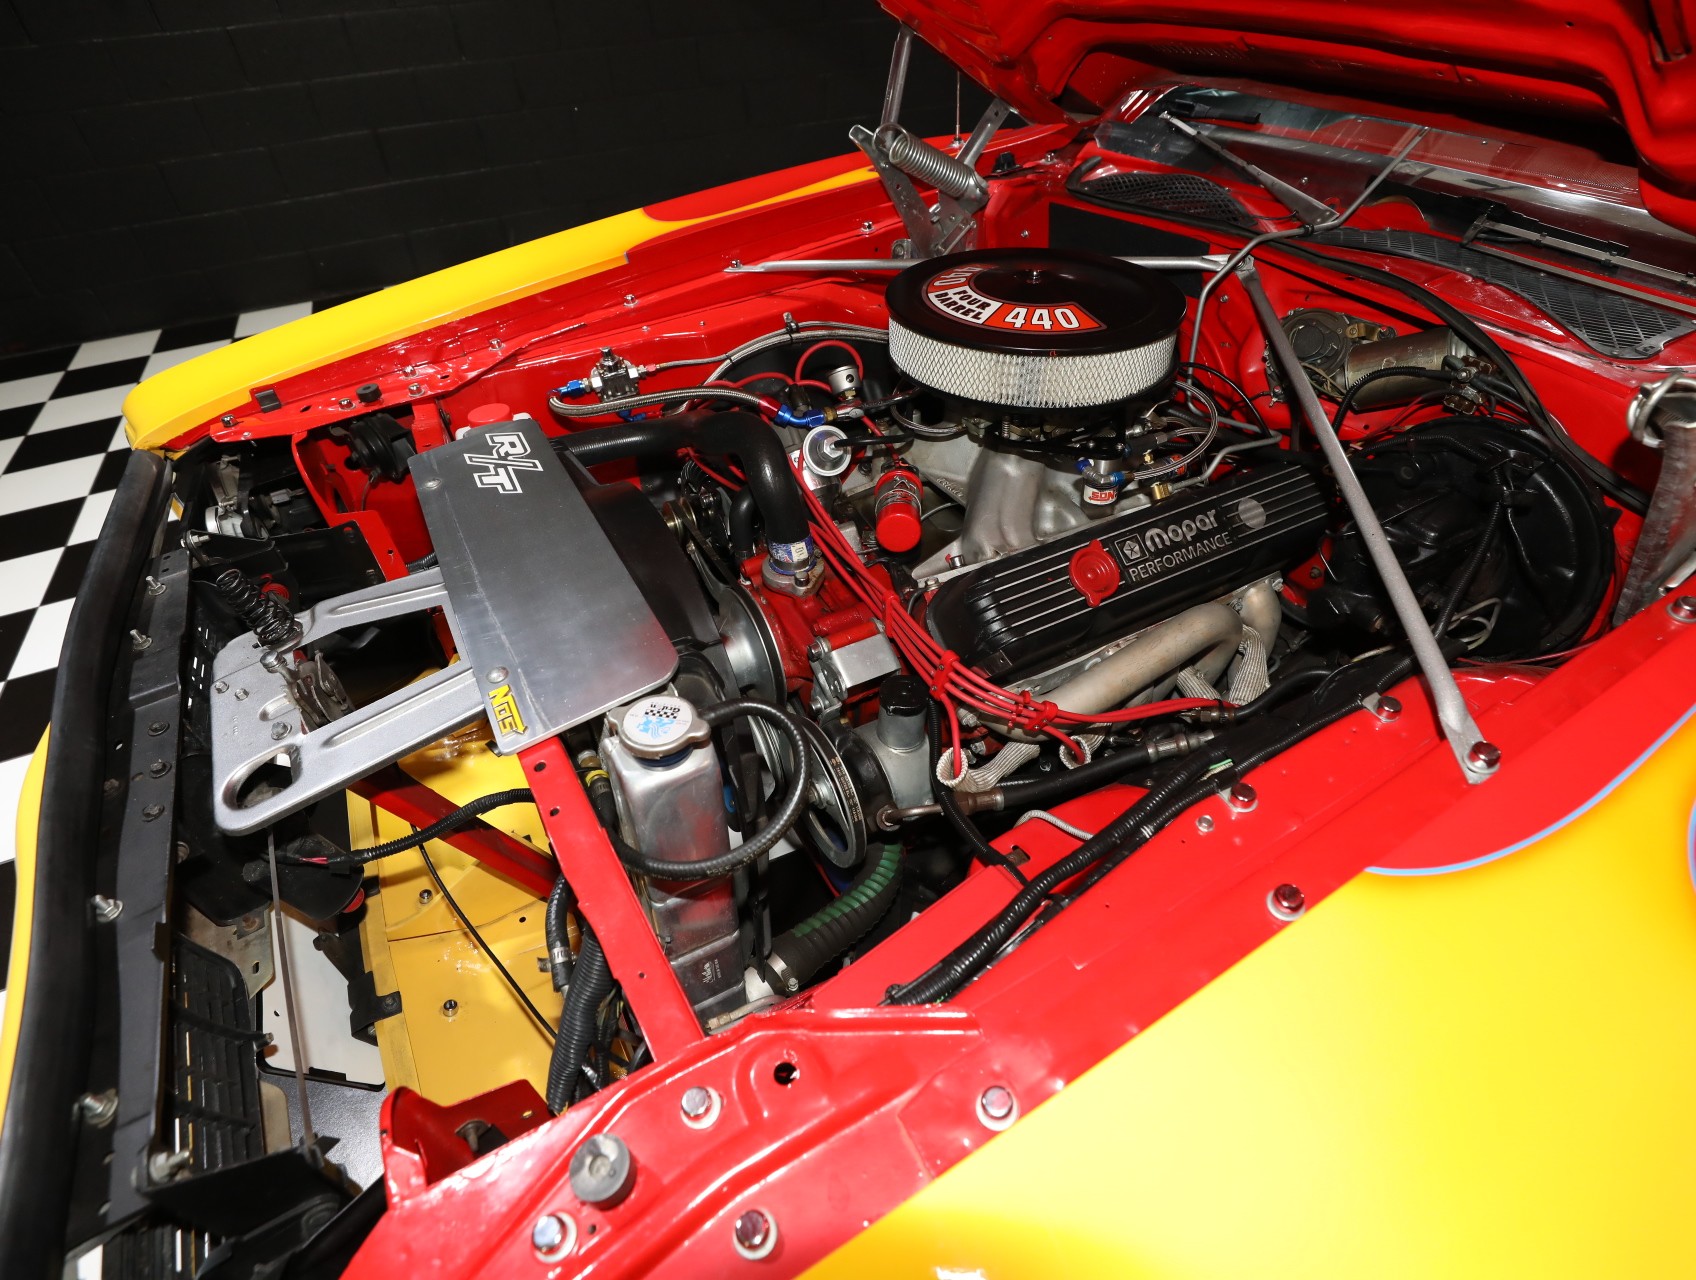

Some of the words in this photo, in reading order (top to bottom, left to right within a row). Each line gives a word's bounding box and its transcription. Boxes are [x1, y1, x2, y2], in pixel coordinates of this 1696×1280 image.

[934, 292, 983, 320] BARREL
[953, 290, 991, 311] FOUR
[1004, 307, 1081, 330] 440
[464, 432, 544, 494] R/T
[1144, 507, 1219, 553] Mopar
[1129, 531, 1233, 582] PERFORMANCE
[488, 684, 528, 738] NOS
[650, 703, 680, 713] Grifn
